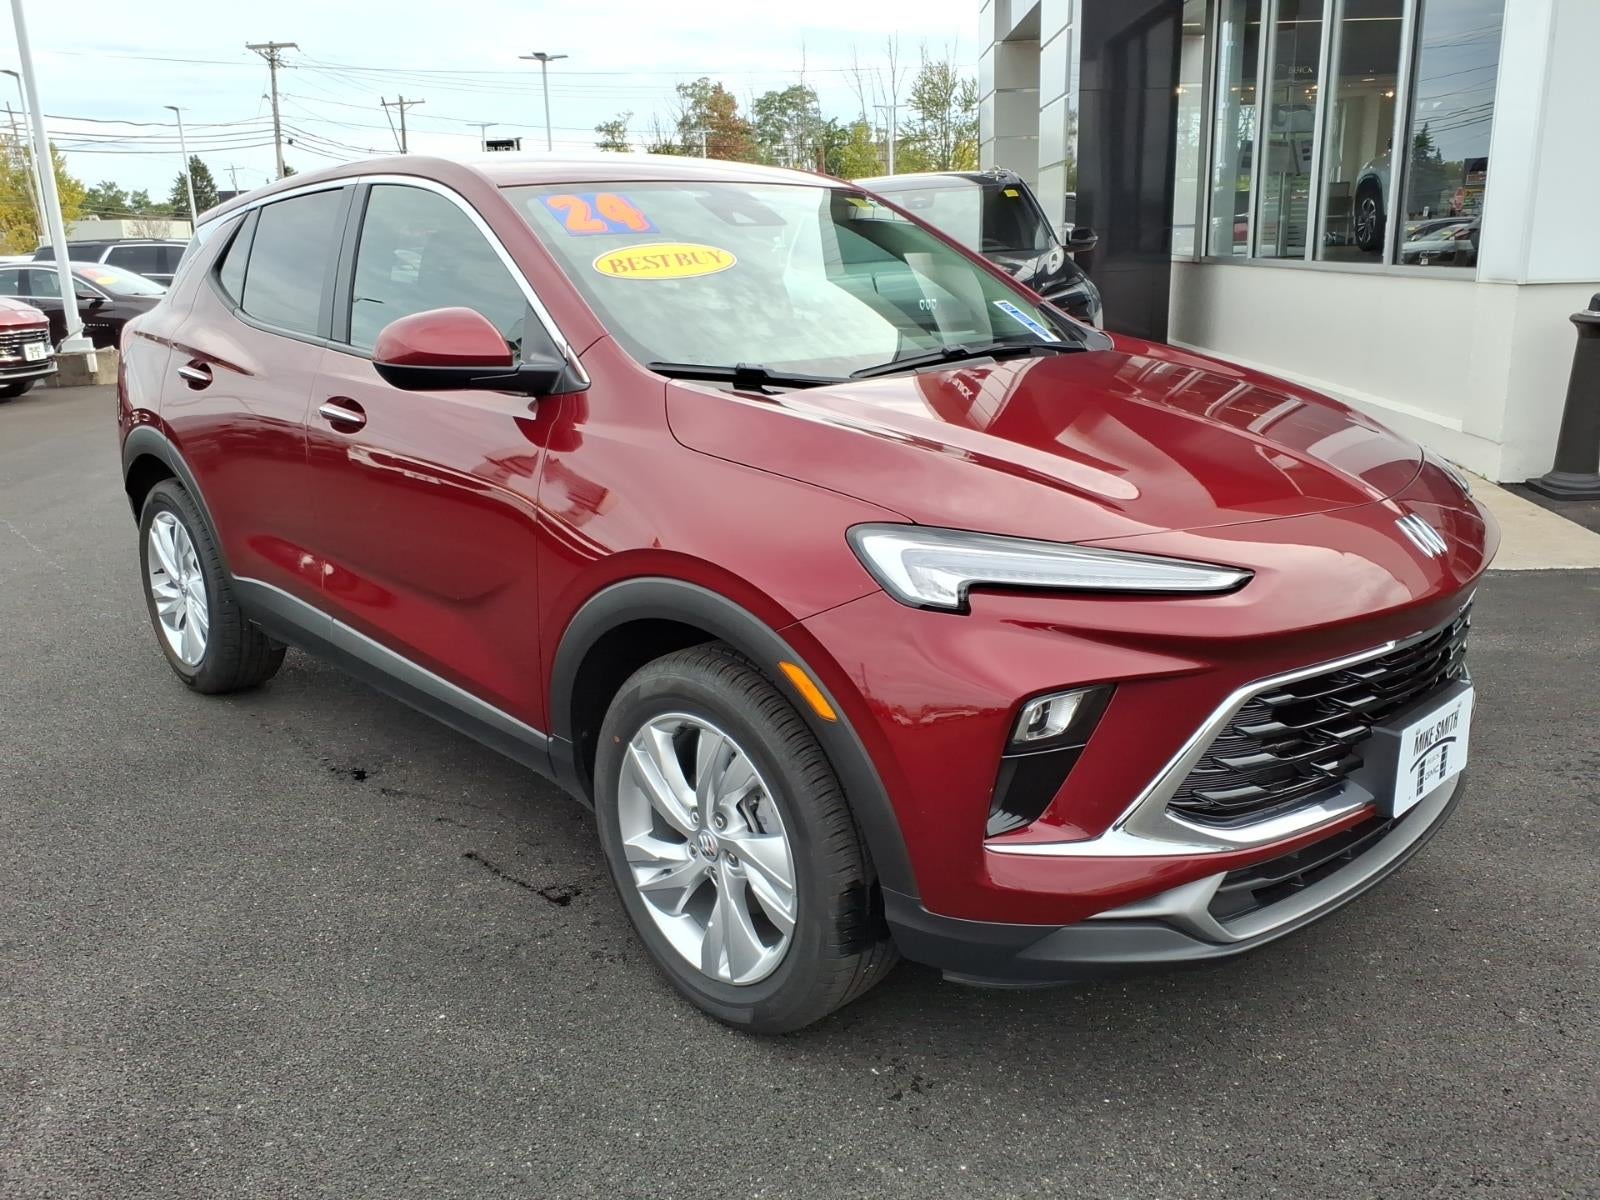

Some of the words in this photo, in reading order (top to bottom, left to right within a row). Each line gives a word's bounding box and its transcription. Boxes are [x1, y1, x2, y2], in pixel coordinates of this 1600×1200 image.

[548, 192, 650, 232] 24
[609, 253, 670, 274] BEST
[674, 250, 722, 267] BUY
[1413, 726, 1434, 757] MIKE
[1435, 711, 1460, 741] SMITH
